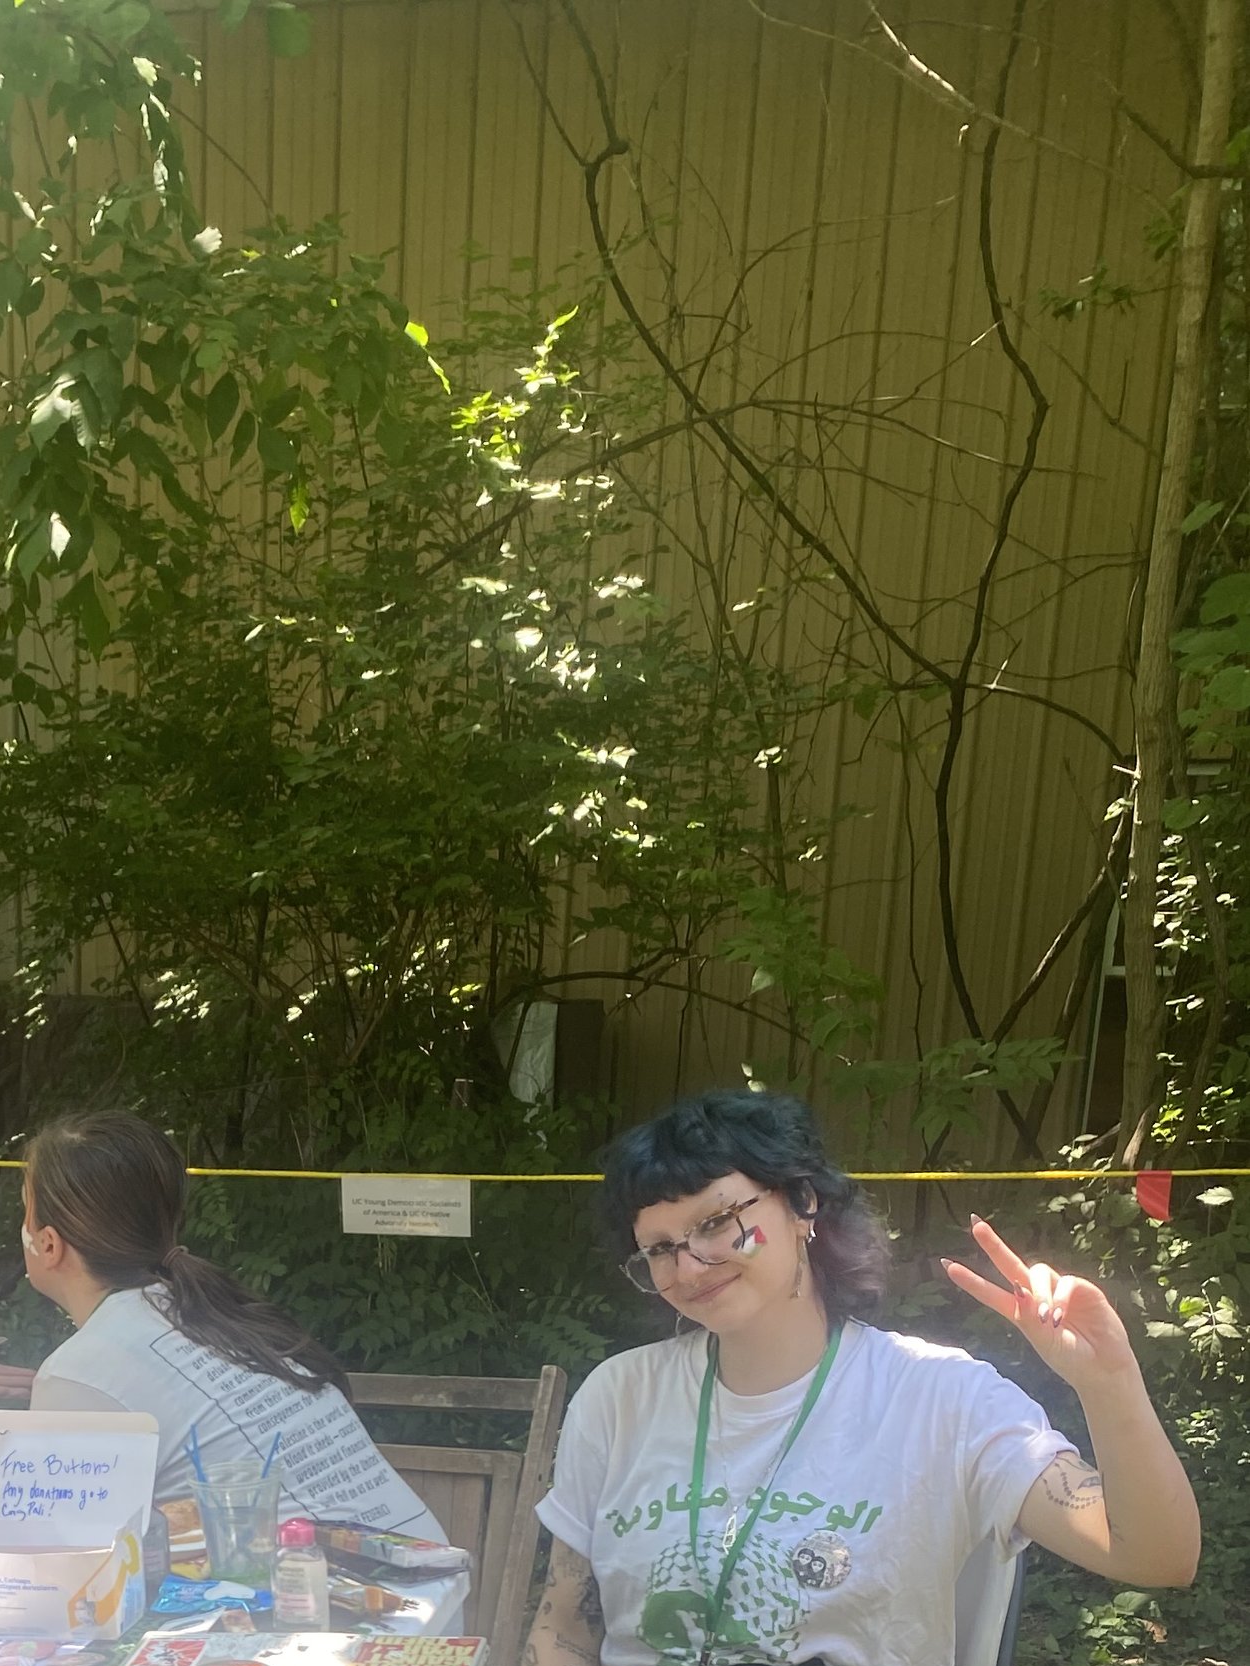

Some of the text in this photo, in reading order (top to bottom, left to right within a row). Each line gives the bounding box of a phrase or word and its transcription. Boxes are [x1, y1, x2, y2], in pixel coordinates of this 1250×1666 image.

[364, 1199, 386, 1207] Young
[1, 1450, 119, 1477] Free Buttons!
[283, 1447, 308, 1468] blood
[295, 1457, 330, 1484] weapons
[2, 1481, 24, 1507] Any
[30, 1480, 73, 1500] donations
[96, 1487, 109, 1500] to
[307, 1474, 340, 1500] provided
